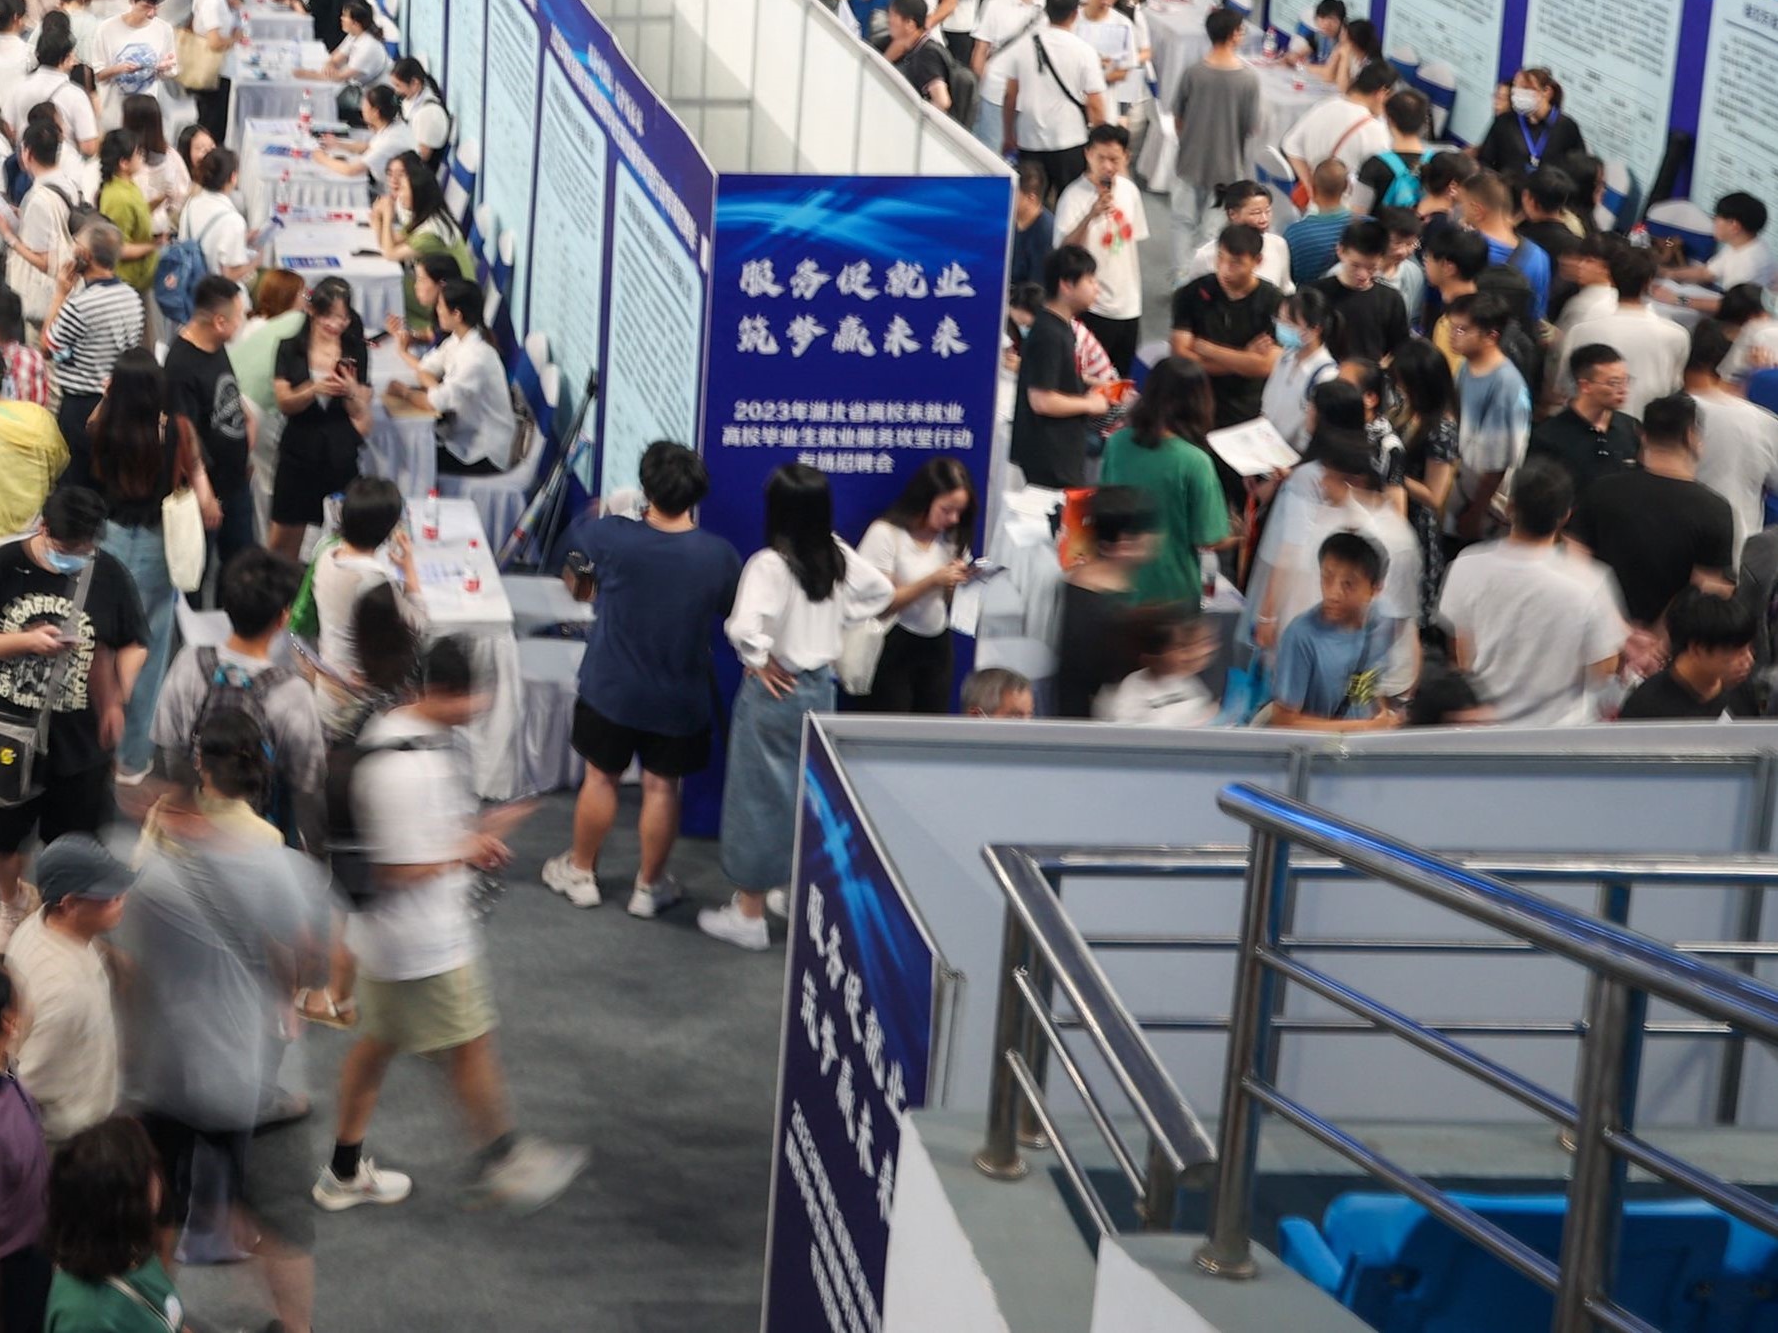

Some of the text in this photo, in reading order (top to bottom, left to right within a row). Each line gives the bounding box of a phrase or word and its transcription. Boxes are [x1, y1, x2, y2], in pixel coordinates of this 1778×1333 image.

[739, 257, 977, 300] 服务促就业
[736, 312, 971, 358] 筑梦赢未来
[733, 399, 965, 424] 2023年湖北省高校未就业
[721, 425, 975, 450] 高校毕业生就业服务攻坚行动
